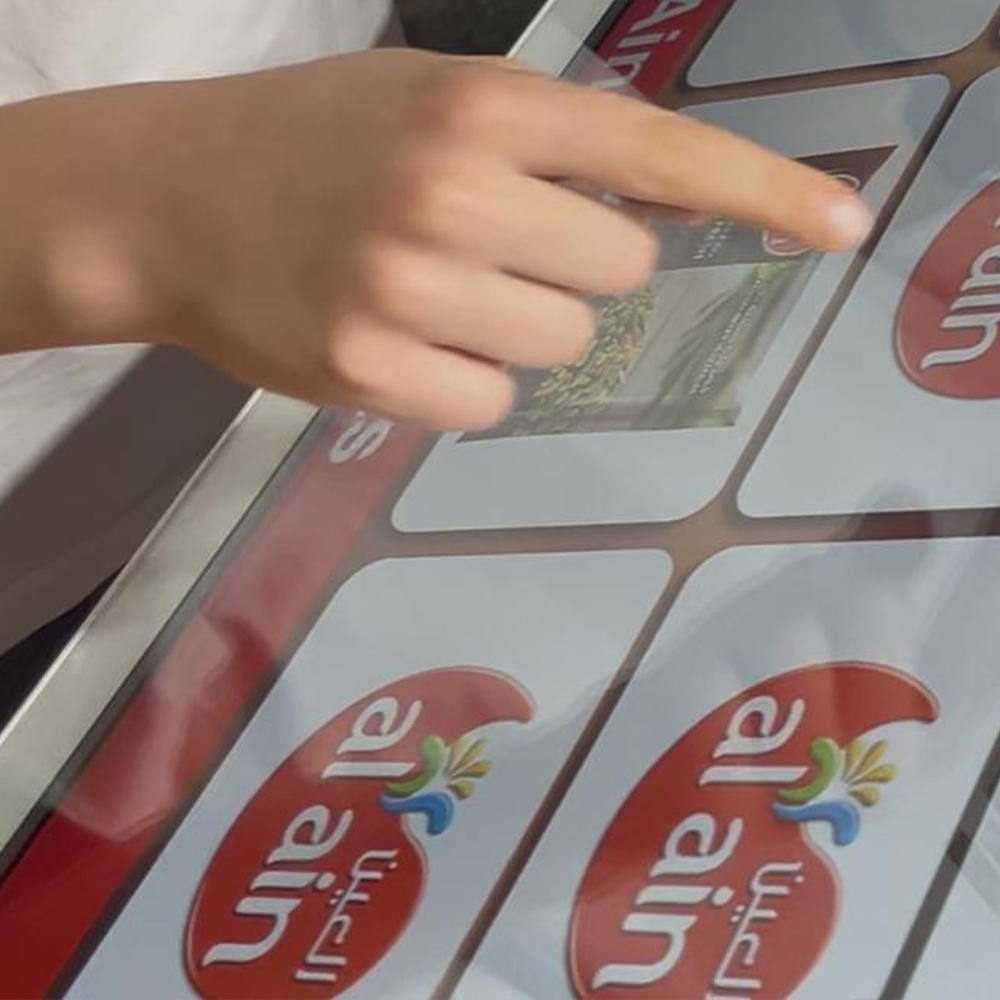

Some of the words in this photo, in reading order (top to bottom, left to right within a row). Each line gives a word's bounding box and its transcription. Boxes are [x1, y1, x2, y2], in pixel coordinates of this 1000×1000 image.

[321, 695, 424, 780] al
[700, 695, 809, 787] al
[203, 804, 354, 967] ain
[294, 848, 399, 983] العين
[591, 812, 744, 990] ain
